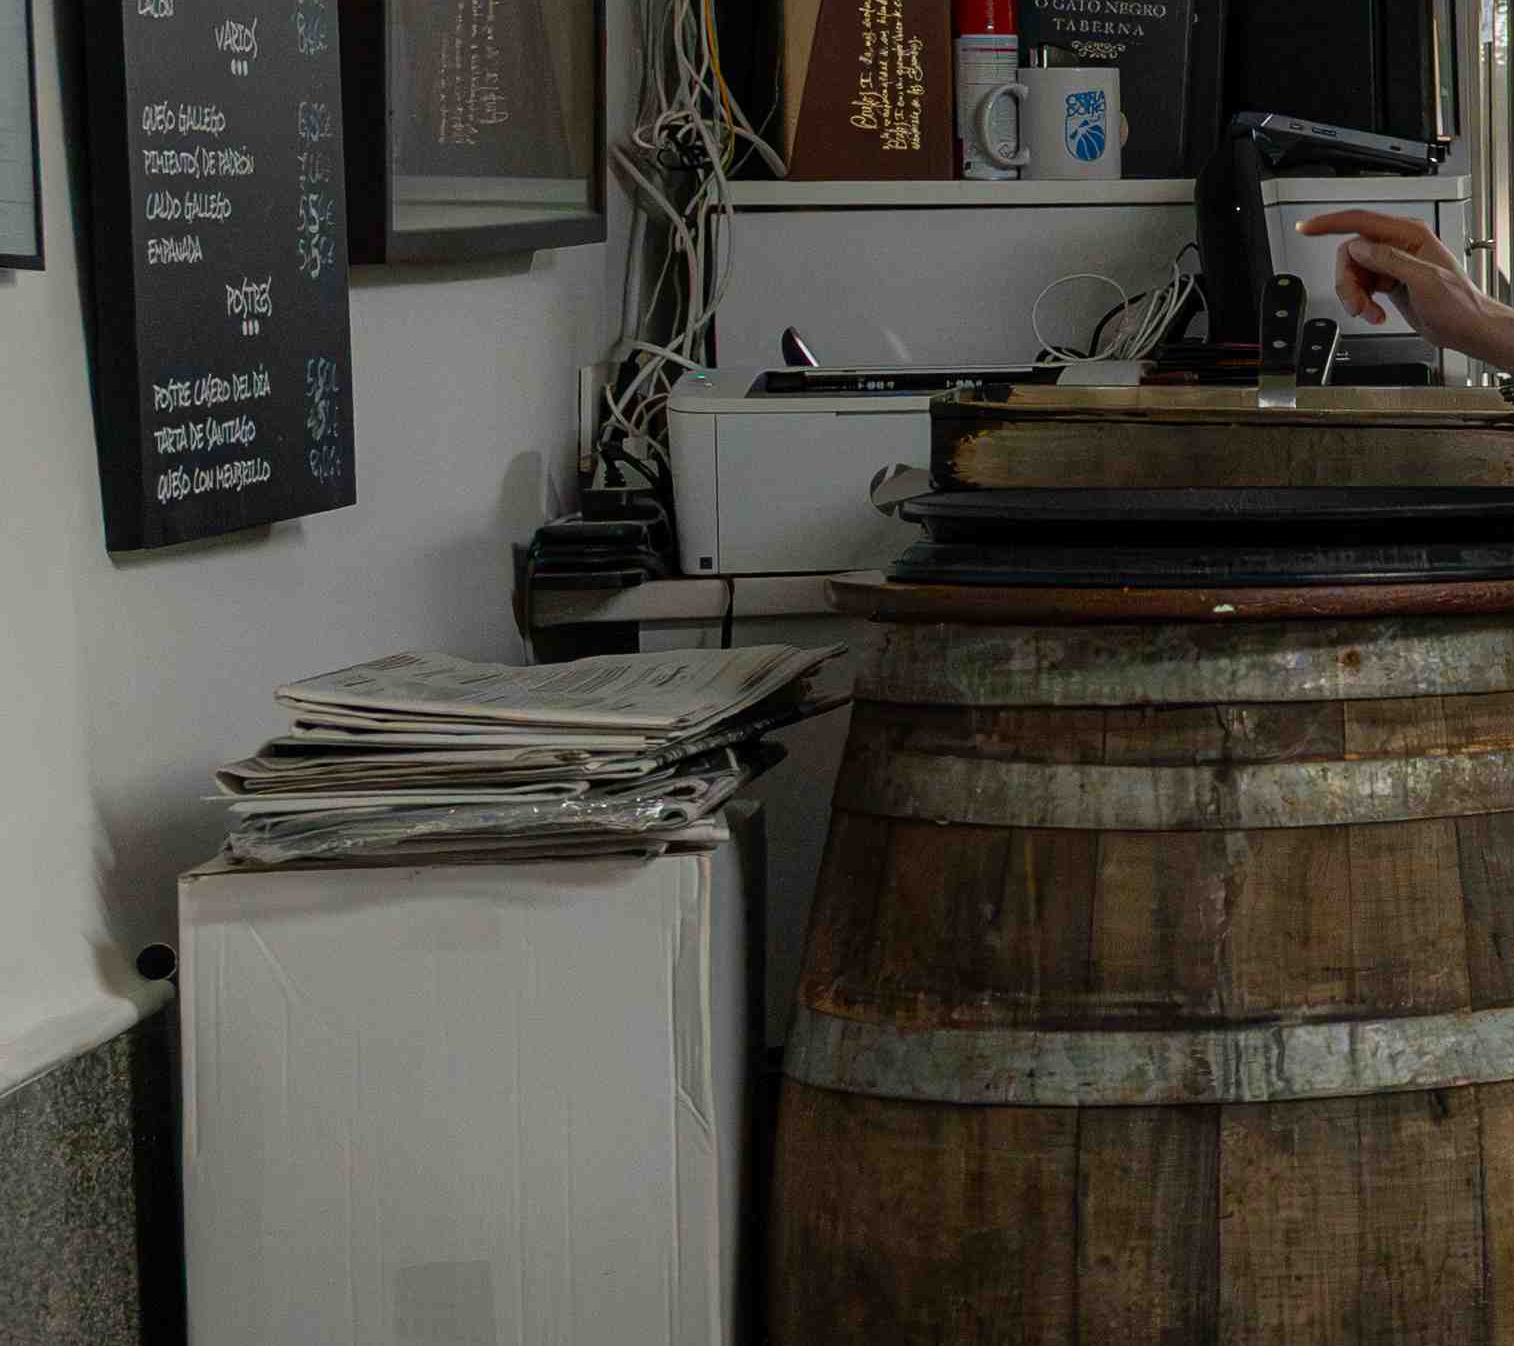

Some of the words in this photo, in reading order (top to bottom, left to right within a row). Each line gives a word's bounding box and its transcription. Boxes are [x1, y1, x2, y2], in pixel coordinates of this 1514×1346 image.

[1052, 18, 1144, 36] TABERNA
[1104, 0, 1167, 18] NEGRO
[214, 16, 257, 60] VARIOS
[141, 100, 175, 136] QUESO
[178, 103, 226, 137] GALLEGO
[142, 145, 200, 180] PIMIENTOS
[202, 150, 215, 177] DE
[145, 191, 181, 222] CALDO
[184, 191, 232, 225] GALLEGO
[146, 234, 204, 266] EMPANADA
[225, 276, 272, 318] POSTRES
[152, 378, 192, 413] POSTRE
[193, 373, 230, 409] CASERO
[231, 371, 251, 402] DEL
[154, 424, 188, 455] TARTA
[189, 421, 204, 451] DE
[205, 415, 256, 451] SANTIAGO
[156, 465, 191, 504] QUESO
[192, 466, 214, 495] CON
